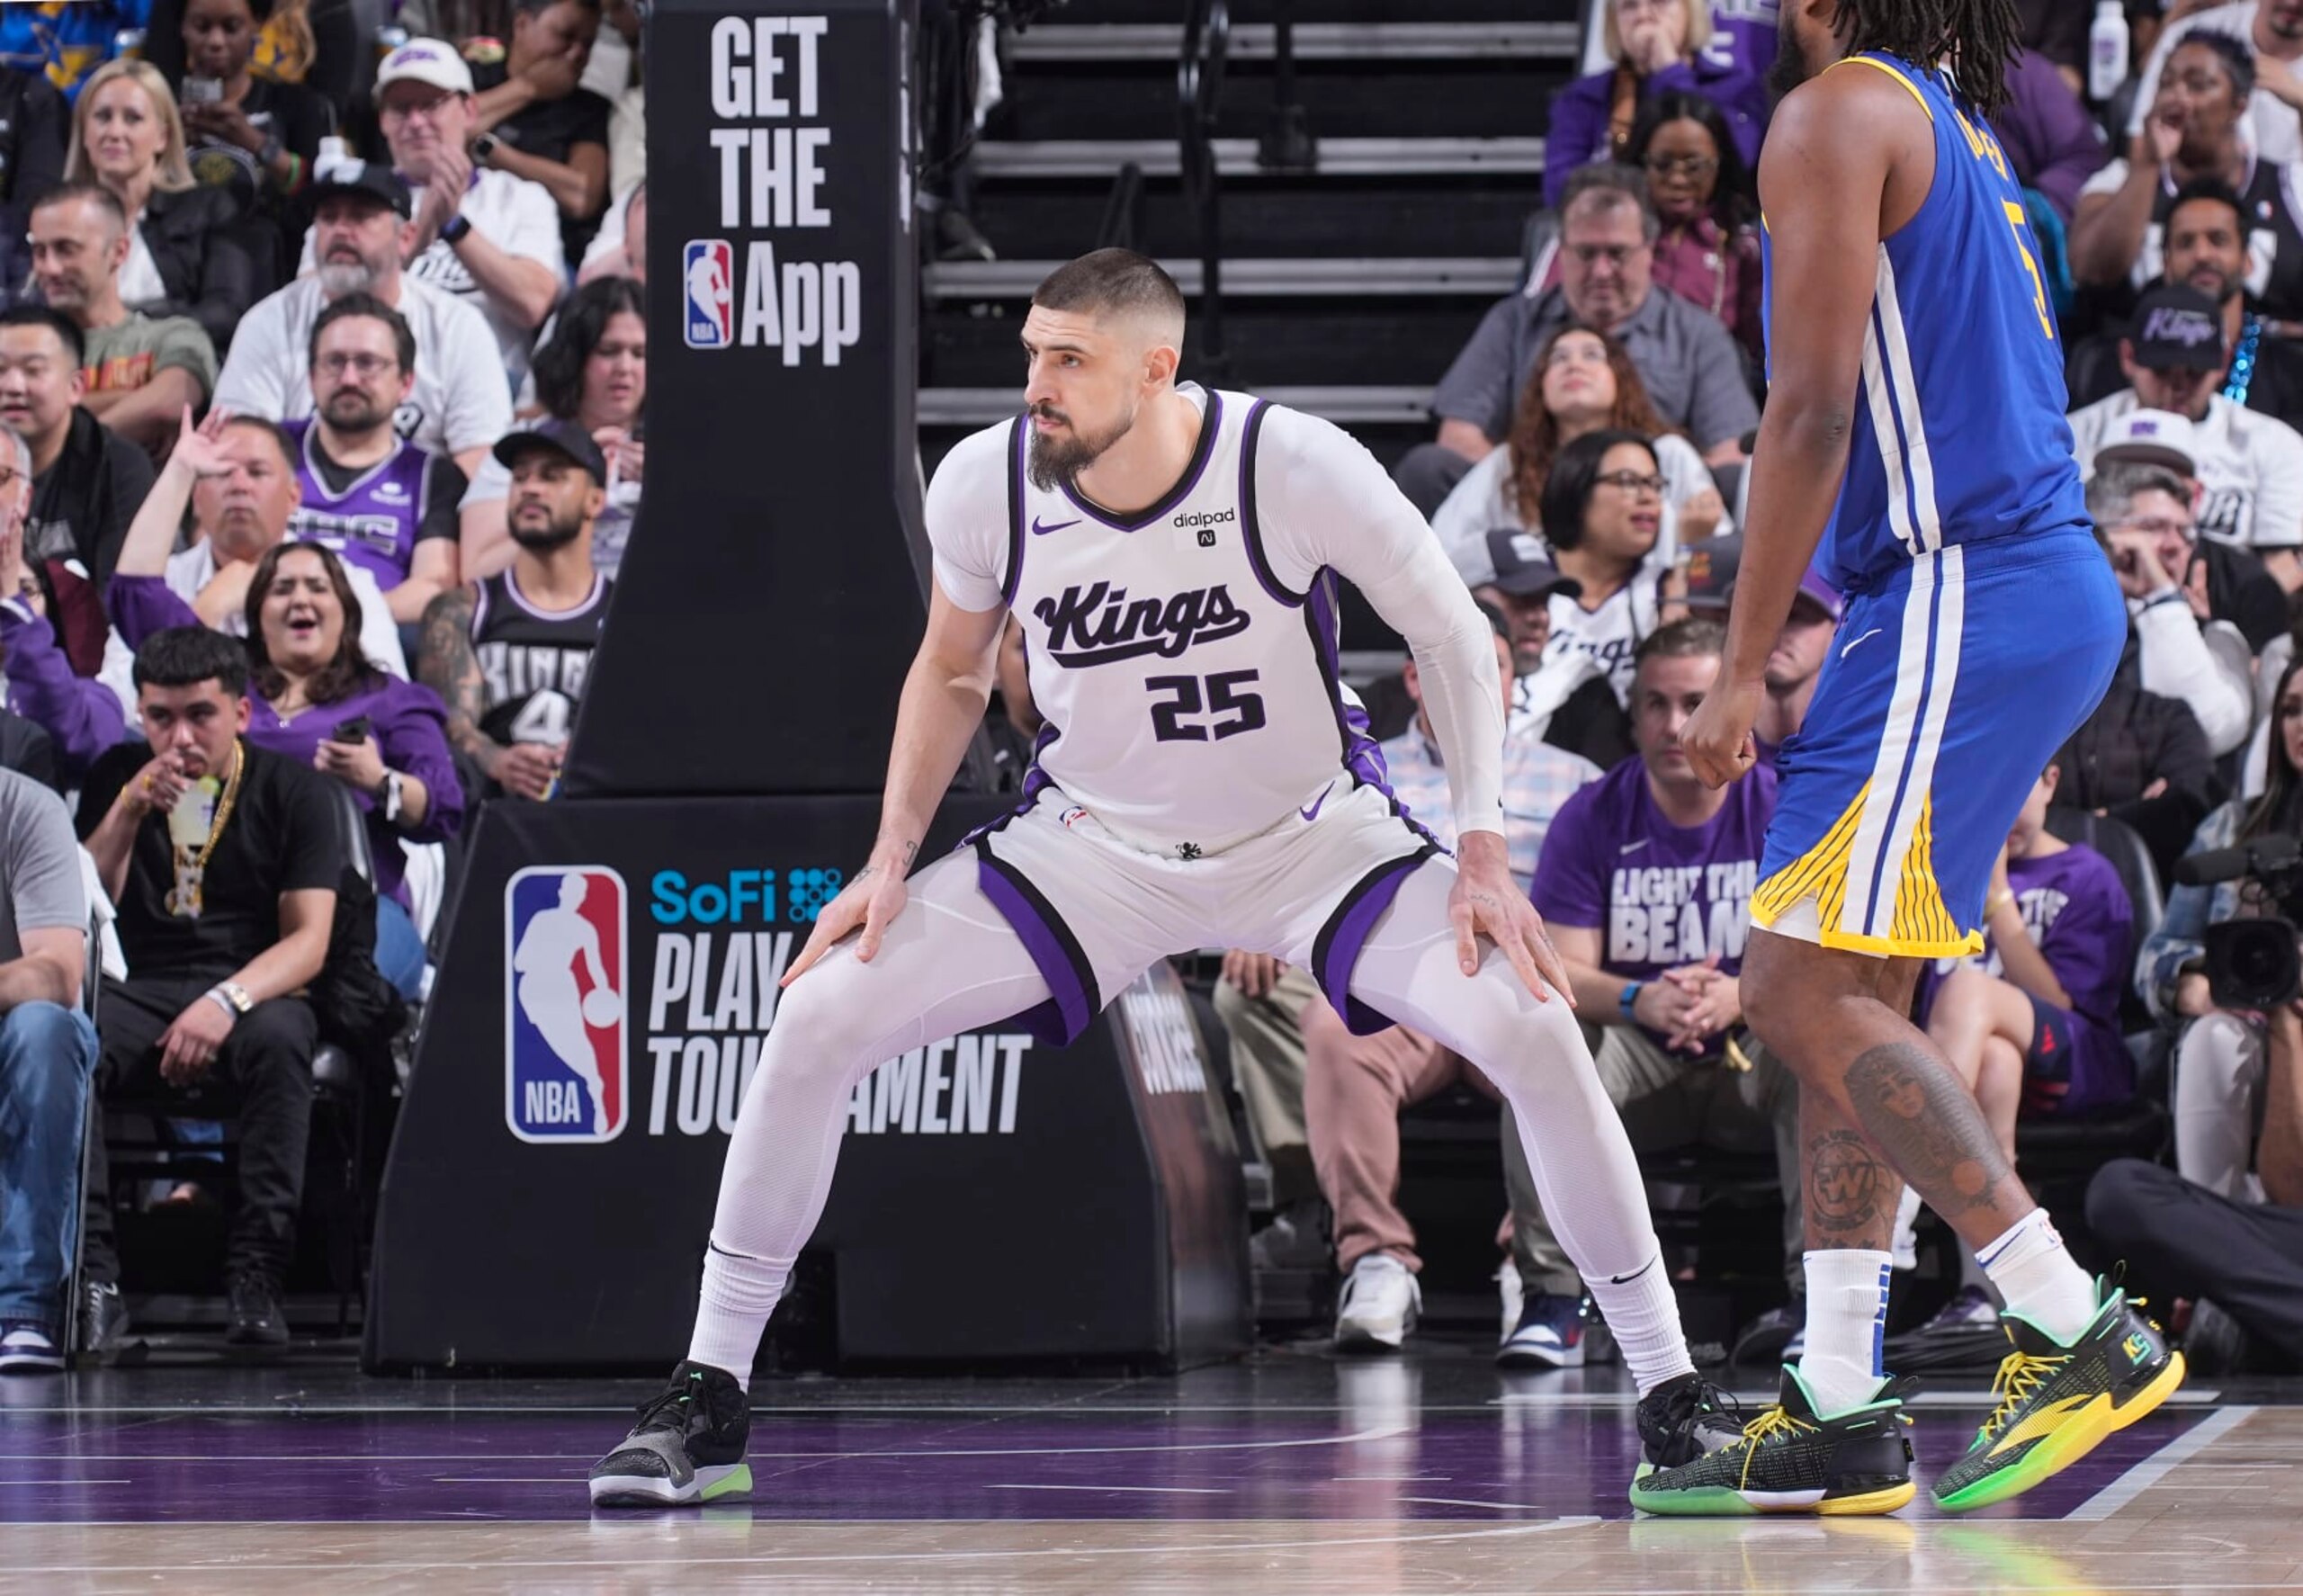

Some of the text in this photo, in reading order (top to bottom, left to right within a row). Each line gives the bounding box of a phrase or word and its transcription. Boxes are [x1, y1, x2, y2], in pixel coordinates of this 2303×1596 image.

[711, 16, 829, 118] GET
[710, 128, 831, 228] THE
[691, 240, 861, 366] NBA App
[1173, 507, 1236, 528] dialpad
[1034, 580, 1250, 668] Kings
[476, 641, 596, 707] KING
[1145, 668, 1267, 742] 25
[509, 689, 571, 746] 4
[650, 869, 776, 925] SoFi
[1610, 866, 1703, 907] LIGHT
[524, 1080, 582, 1124] NBA
[647, 1034, 1034, 1135] TOUAMENT
